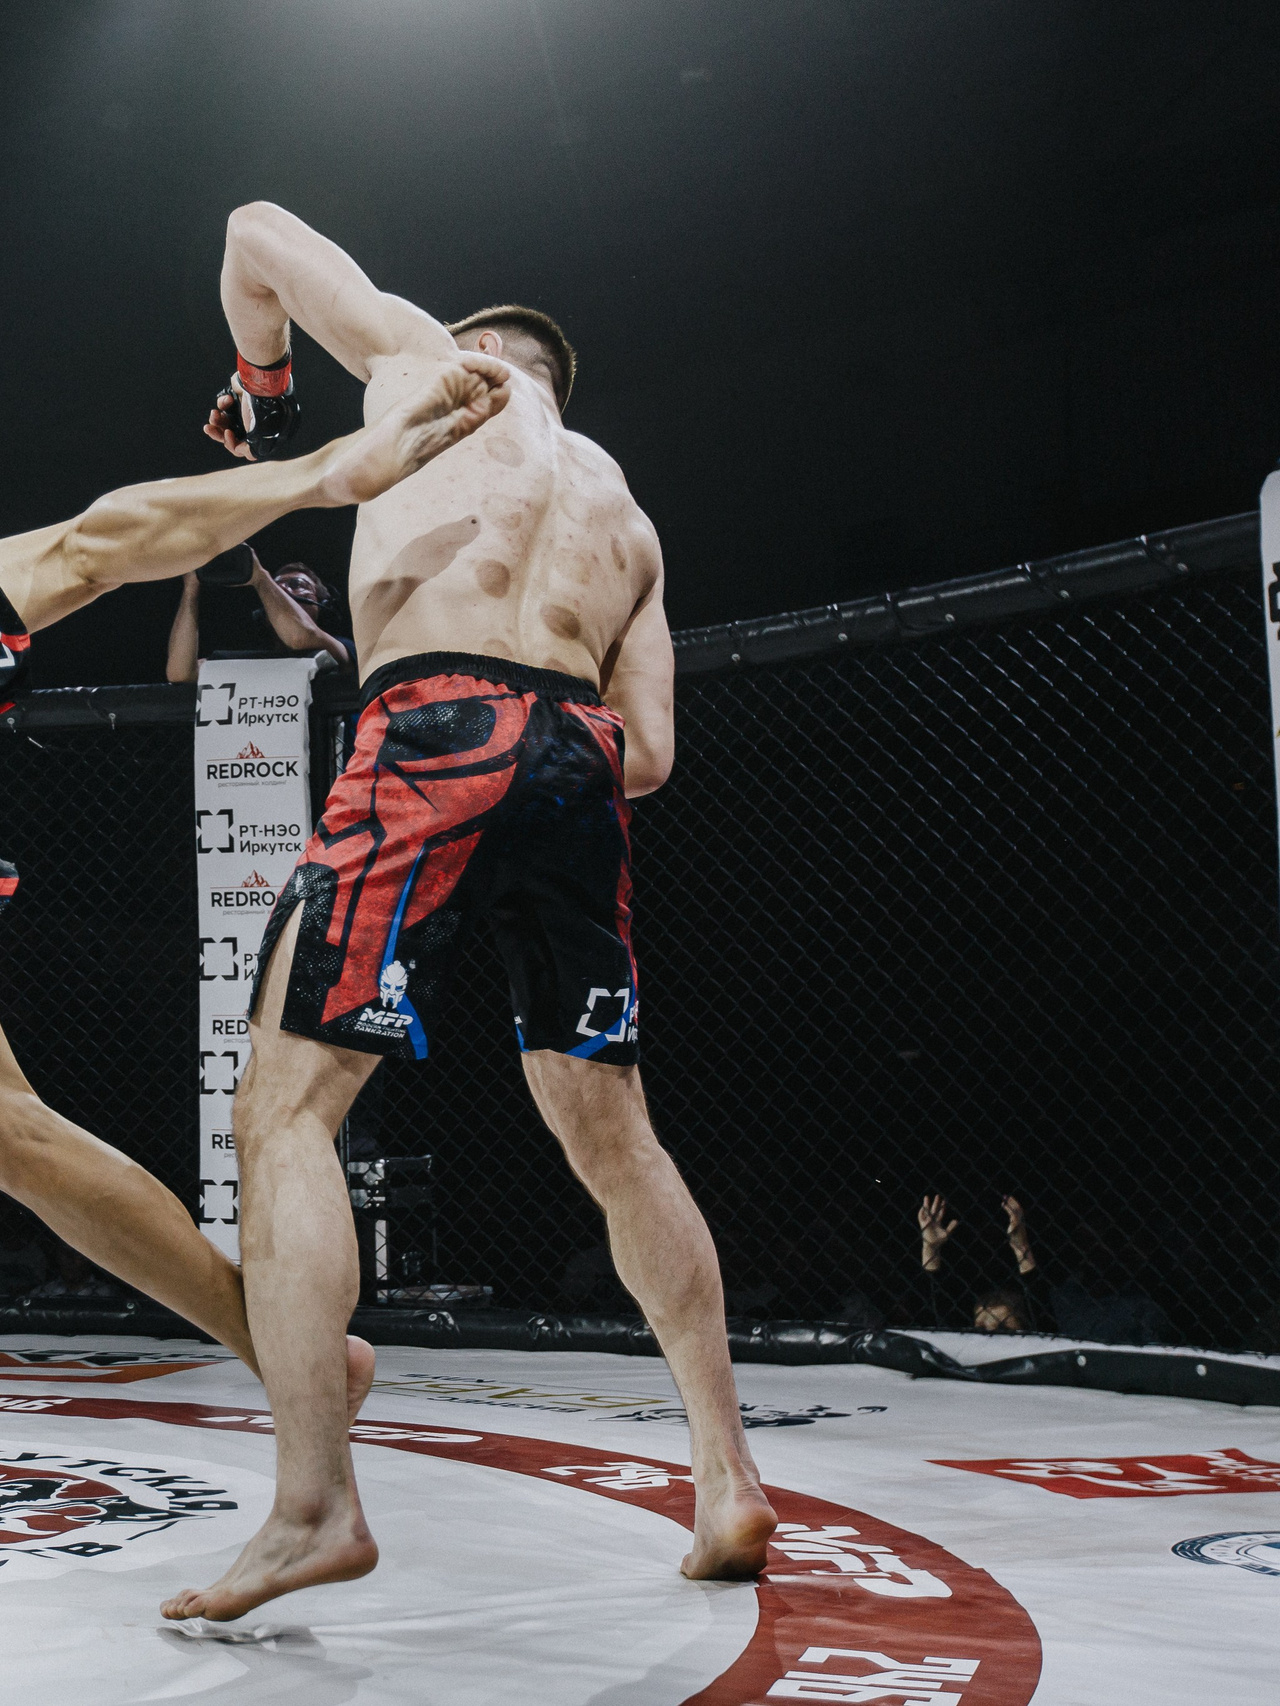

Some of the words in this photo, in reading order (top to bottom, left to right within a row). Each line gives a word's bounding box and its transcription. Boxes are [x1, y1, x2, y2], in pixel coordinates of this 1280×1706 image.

[238, 695, 299, 710] РТ-НЭО
[237, 711, 299, 727] Иркутск
[207, 761, 299, 780] REDROCK
[239, 824, 301, 838] РТ-НЭО
[240, 840, 302, 856] Иркутск
[211, 891, 276, 907] REDRO
[360, 1007, 414, 1028] MFP
[354, 1025, 405, 1038] PANKRATION
[767, 1522, 953, 1598] MFP
